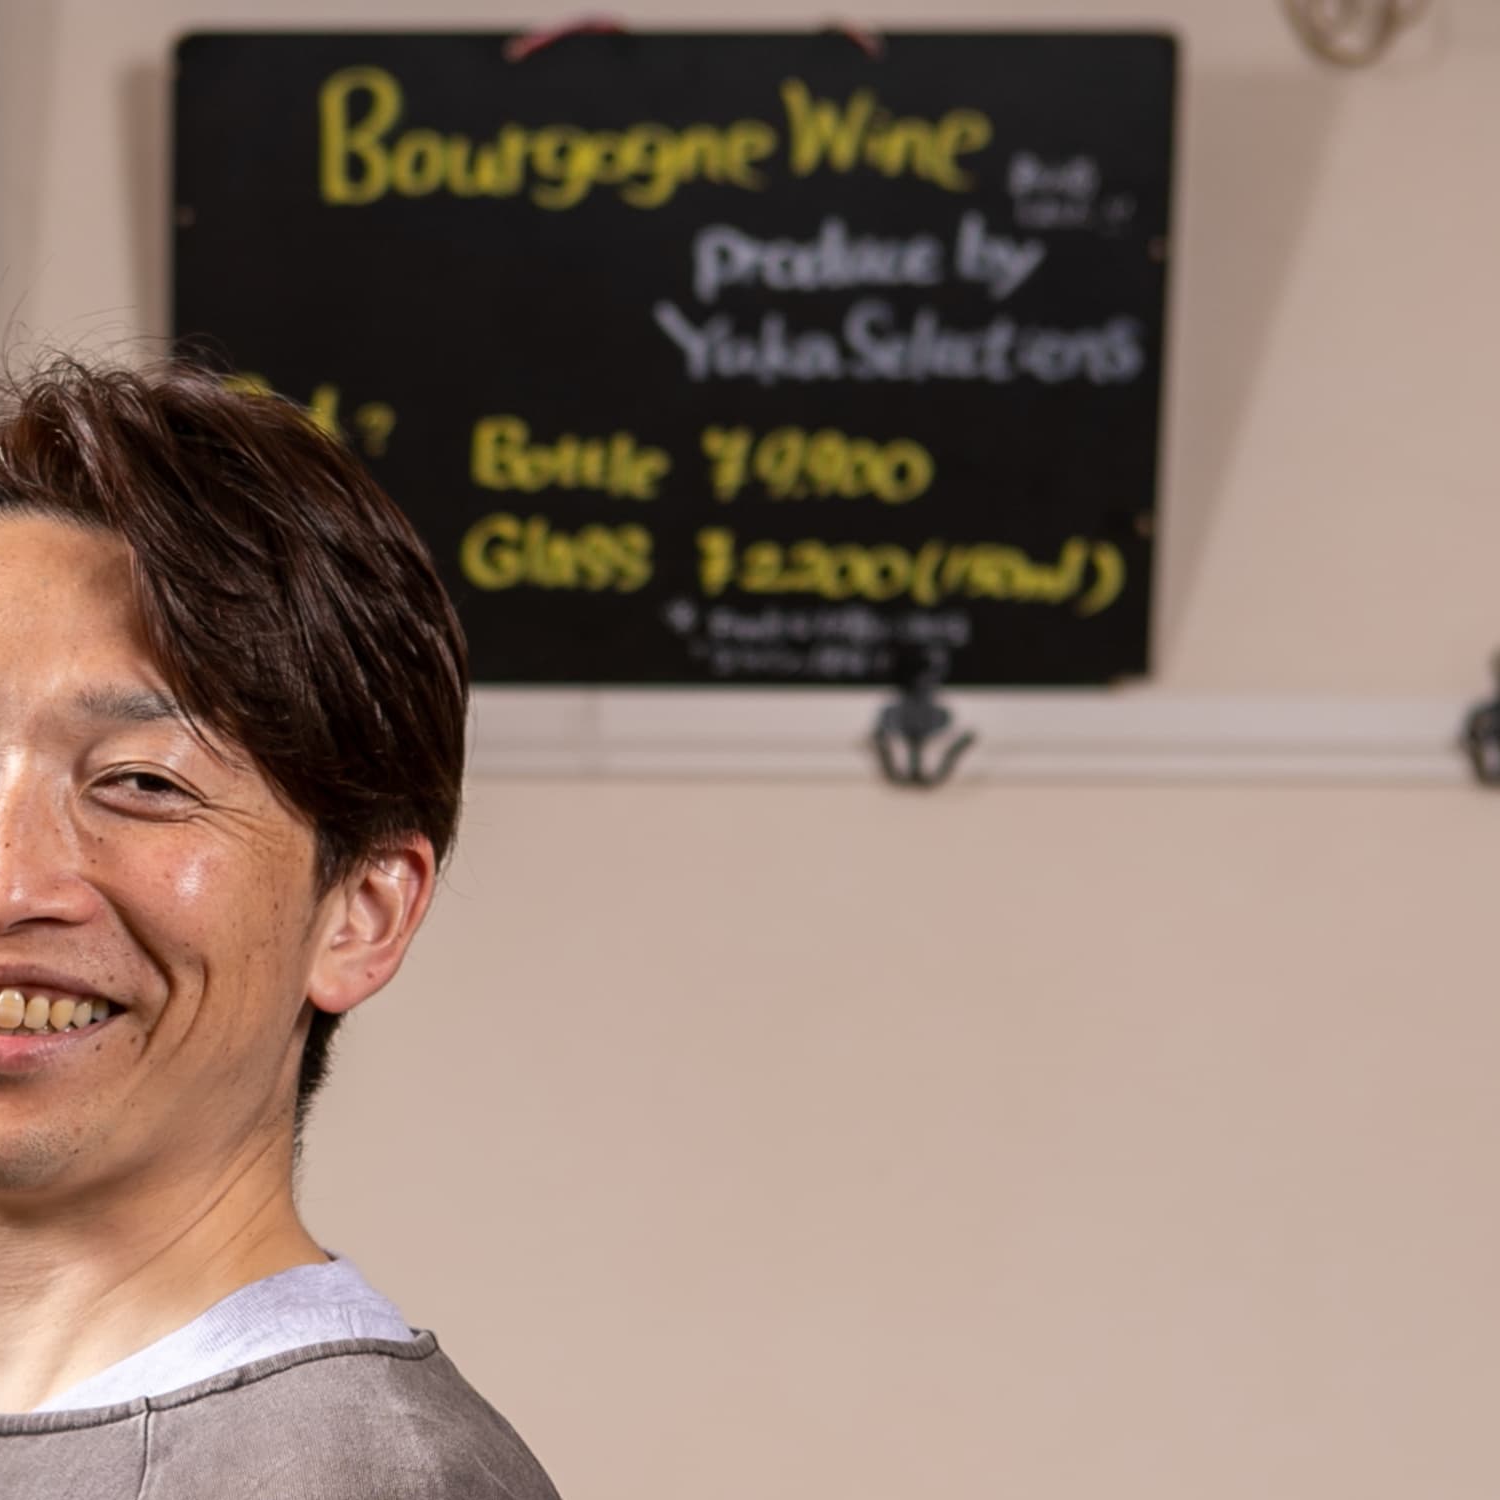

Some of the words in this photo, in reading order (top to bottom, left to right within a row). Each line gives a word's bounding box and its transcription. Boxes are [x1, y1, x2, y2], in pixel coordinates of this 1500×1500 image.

[319, 65, 776, 211] Bourgogne
[781, 77, 993, 192] Wine
[956, 209, 1046, 299] by
[471, 414, 671, 499] Bottle
[460, 512, 653, 592] Glass
